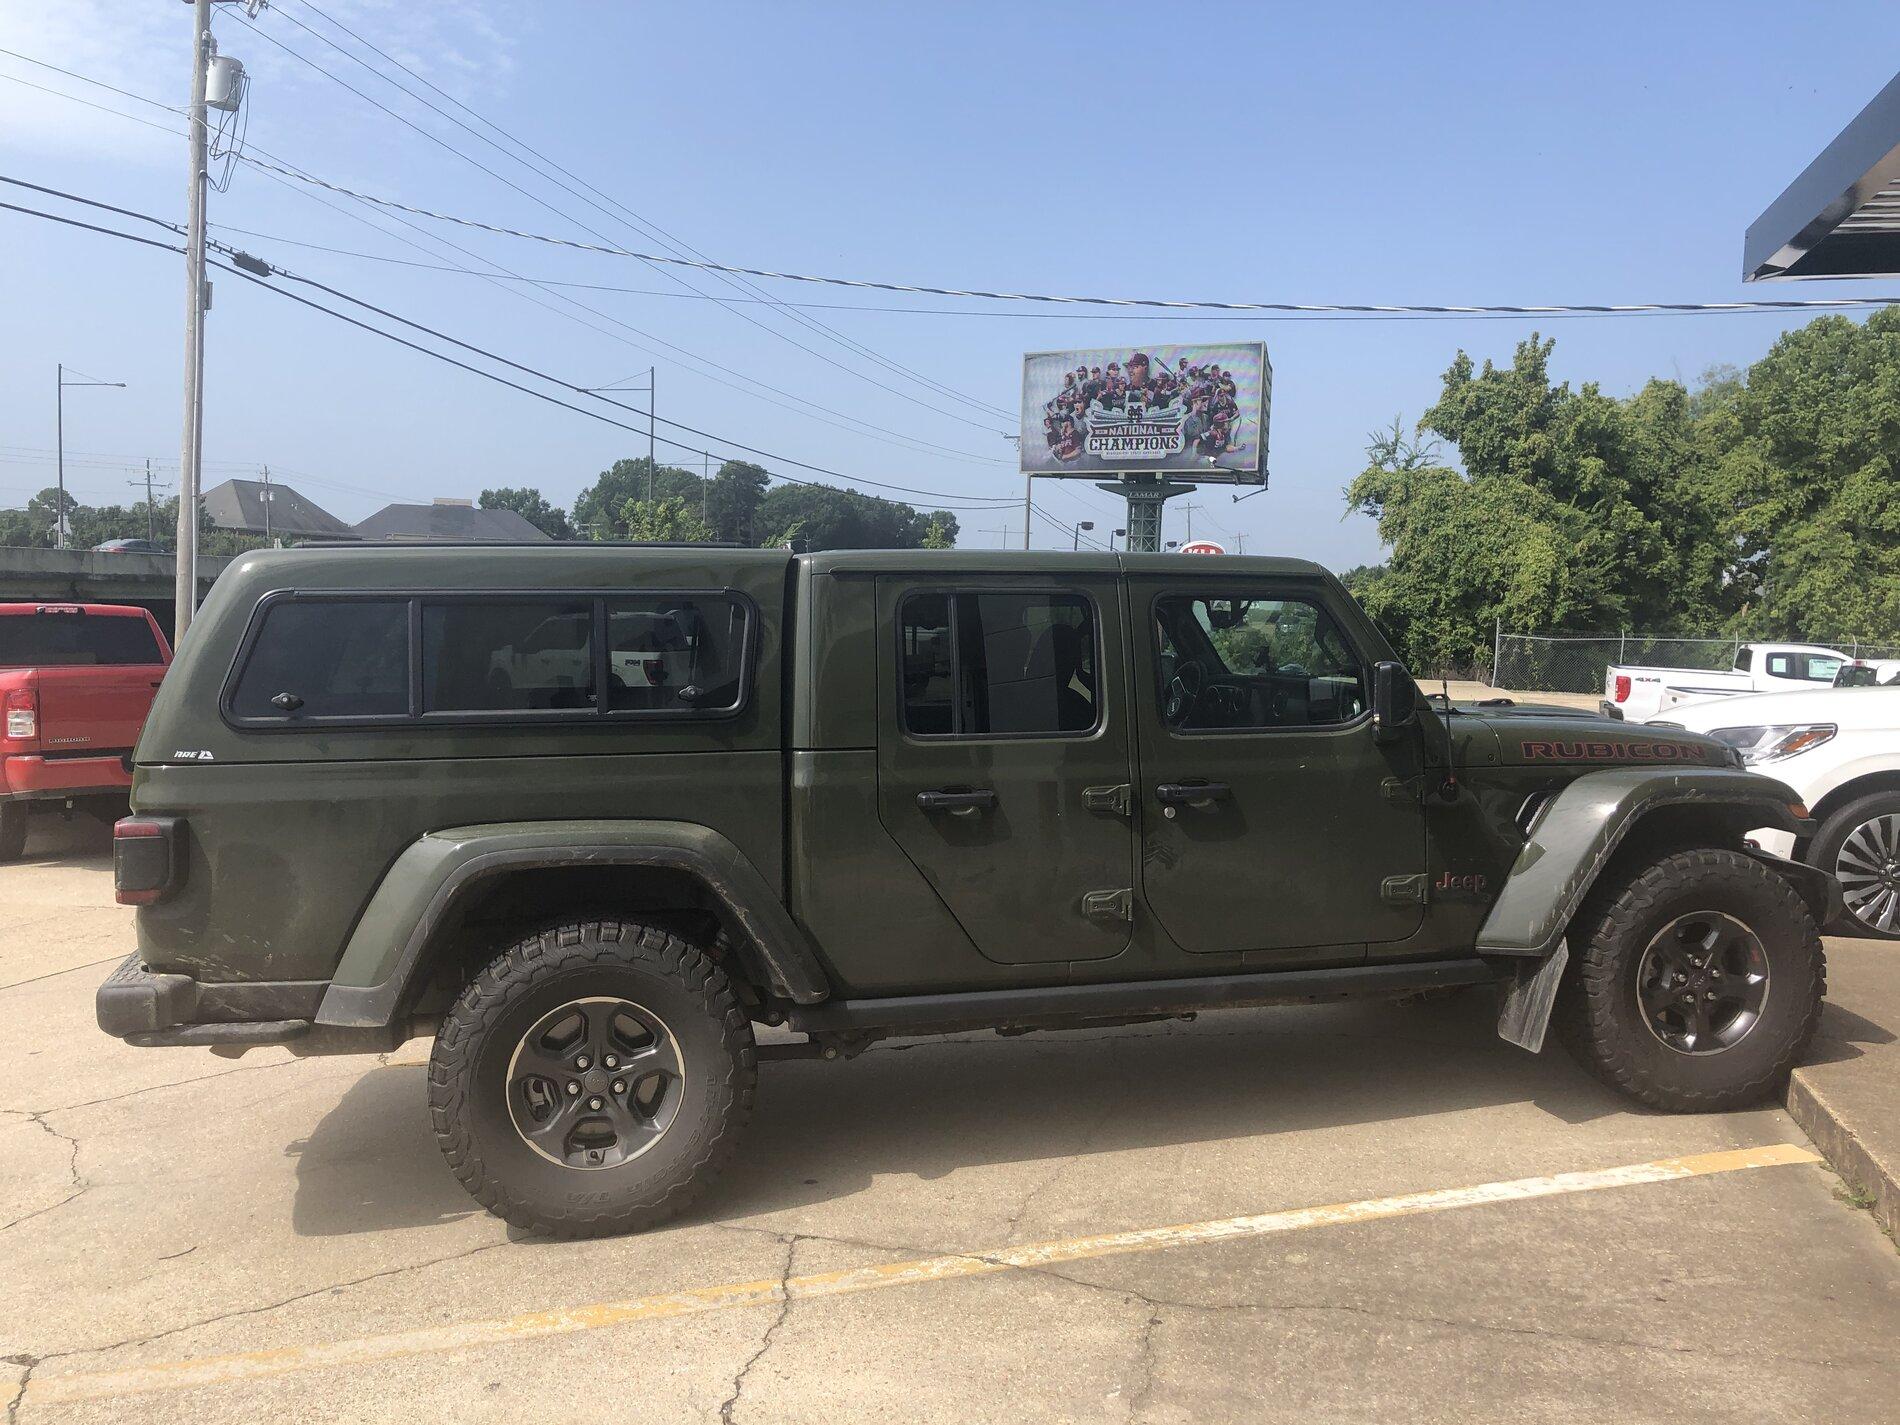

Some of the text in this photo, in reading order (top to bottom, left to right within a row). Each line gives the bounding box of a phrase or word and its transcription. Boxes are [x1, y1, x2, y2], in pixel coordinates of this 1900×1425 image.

[1109, 424, 1160, 436] NATIONAL
[1089, 436, 1179, 451] CHAMPIONS
[1521, 741, 1706, 760] RUBICON
[1434, 871, 1487, 895] Jeep
